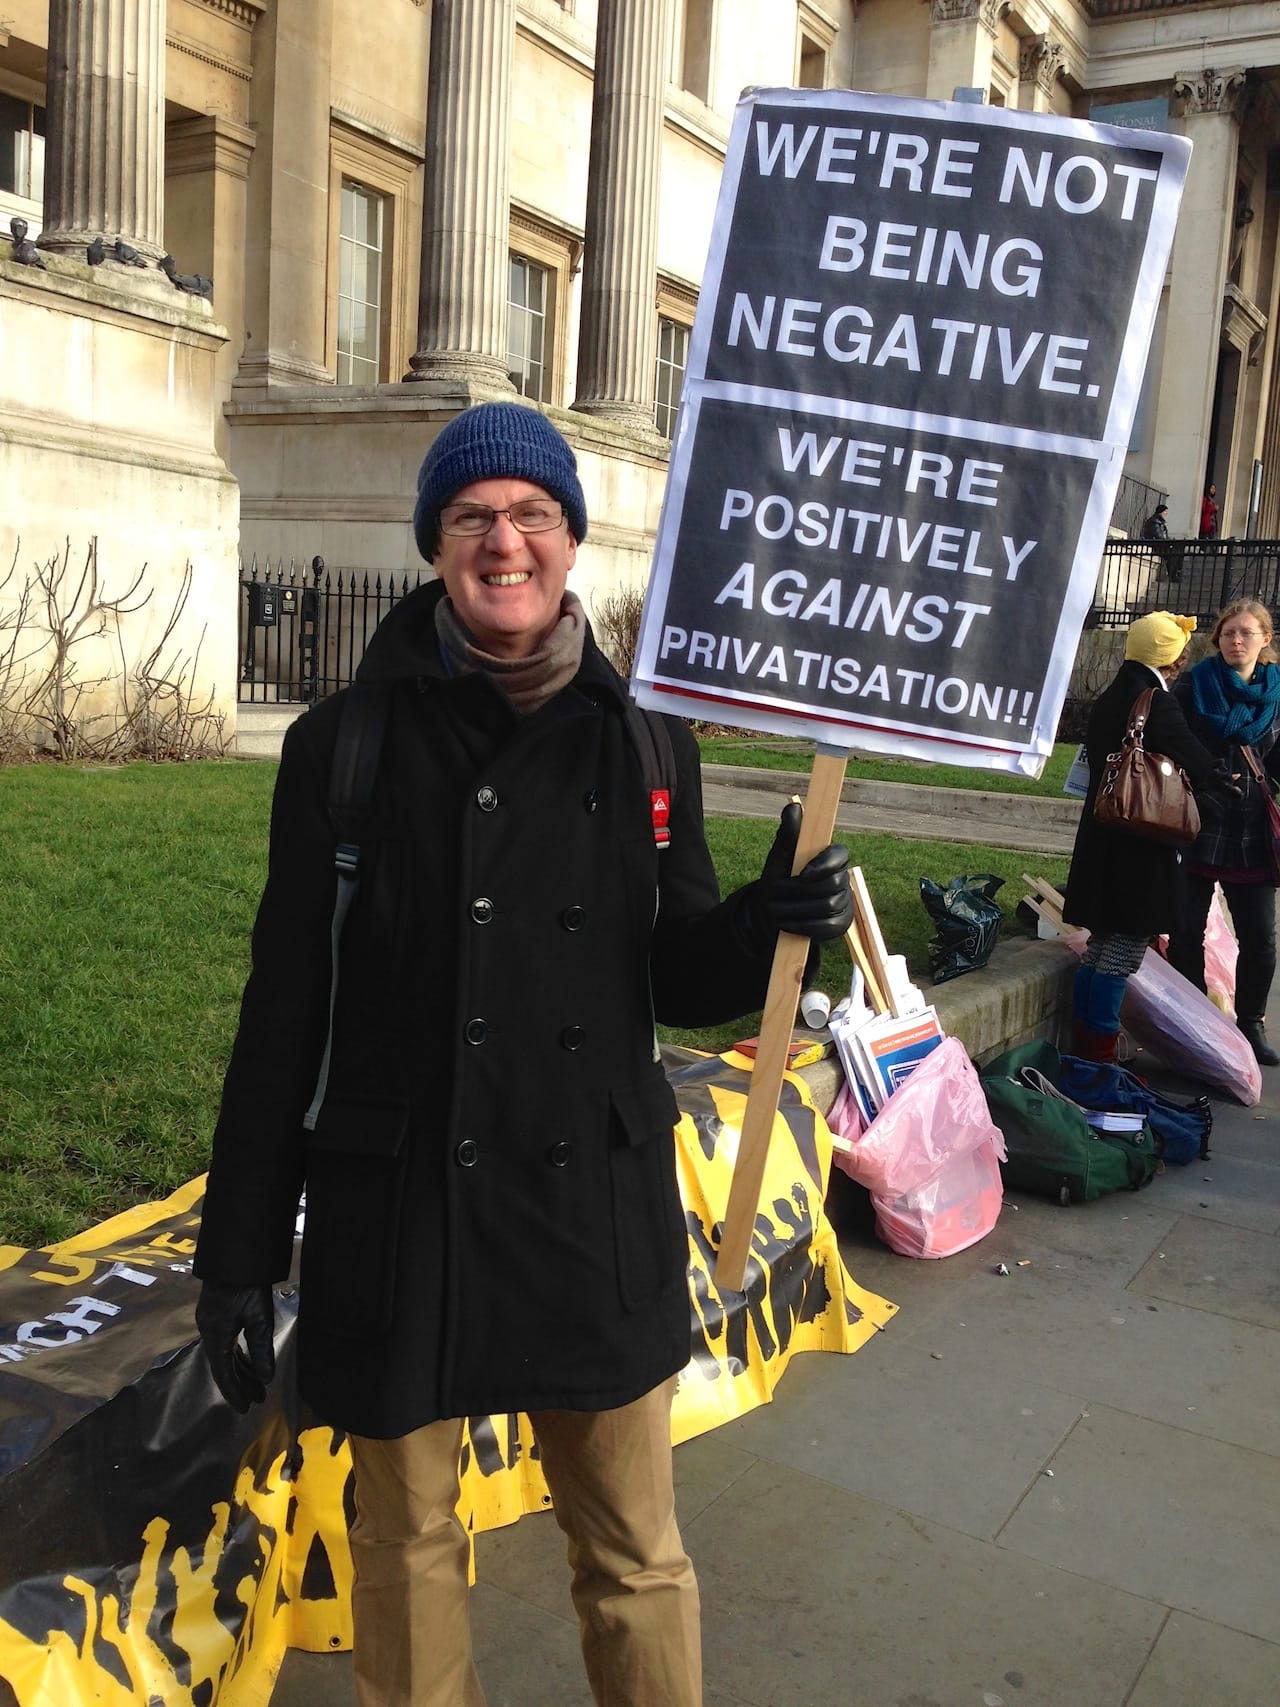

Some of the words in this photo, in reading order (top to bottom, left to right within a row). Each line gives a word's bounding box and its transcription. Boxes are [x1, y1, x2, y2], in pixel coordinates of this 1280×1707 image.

[757, 121, 979, 198] WE'RE
[999, 147, 1158, 221] NOT
[819, 216, 1044, 298] BEING
[728, 293, 1101, 398] NEGATIVE.
[778, 428, 1004, 507] WE'RE
[720, 489, 1037, 581] POSITIVELY
[715, 563, 991, 649] AGAINST
[661, 626, 1034, 727] PRIVATISATION!!
